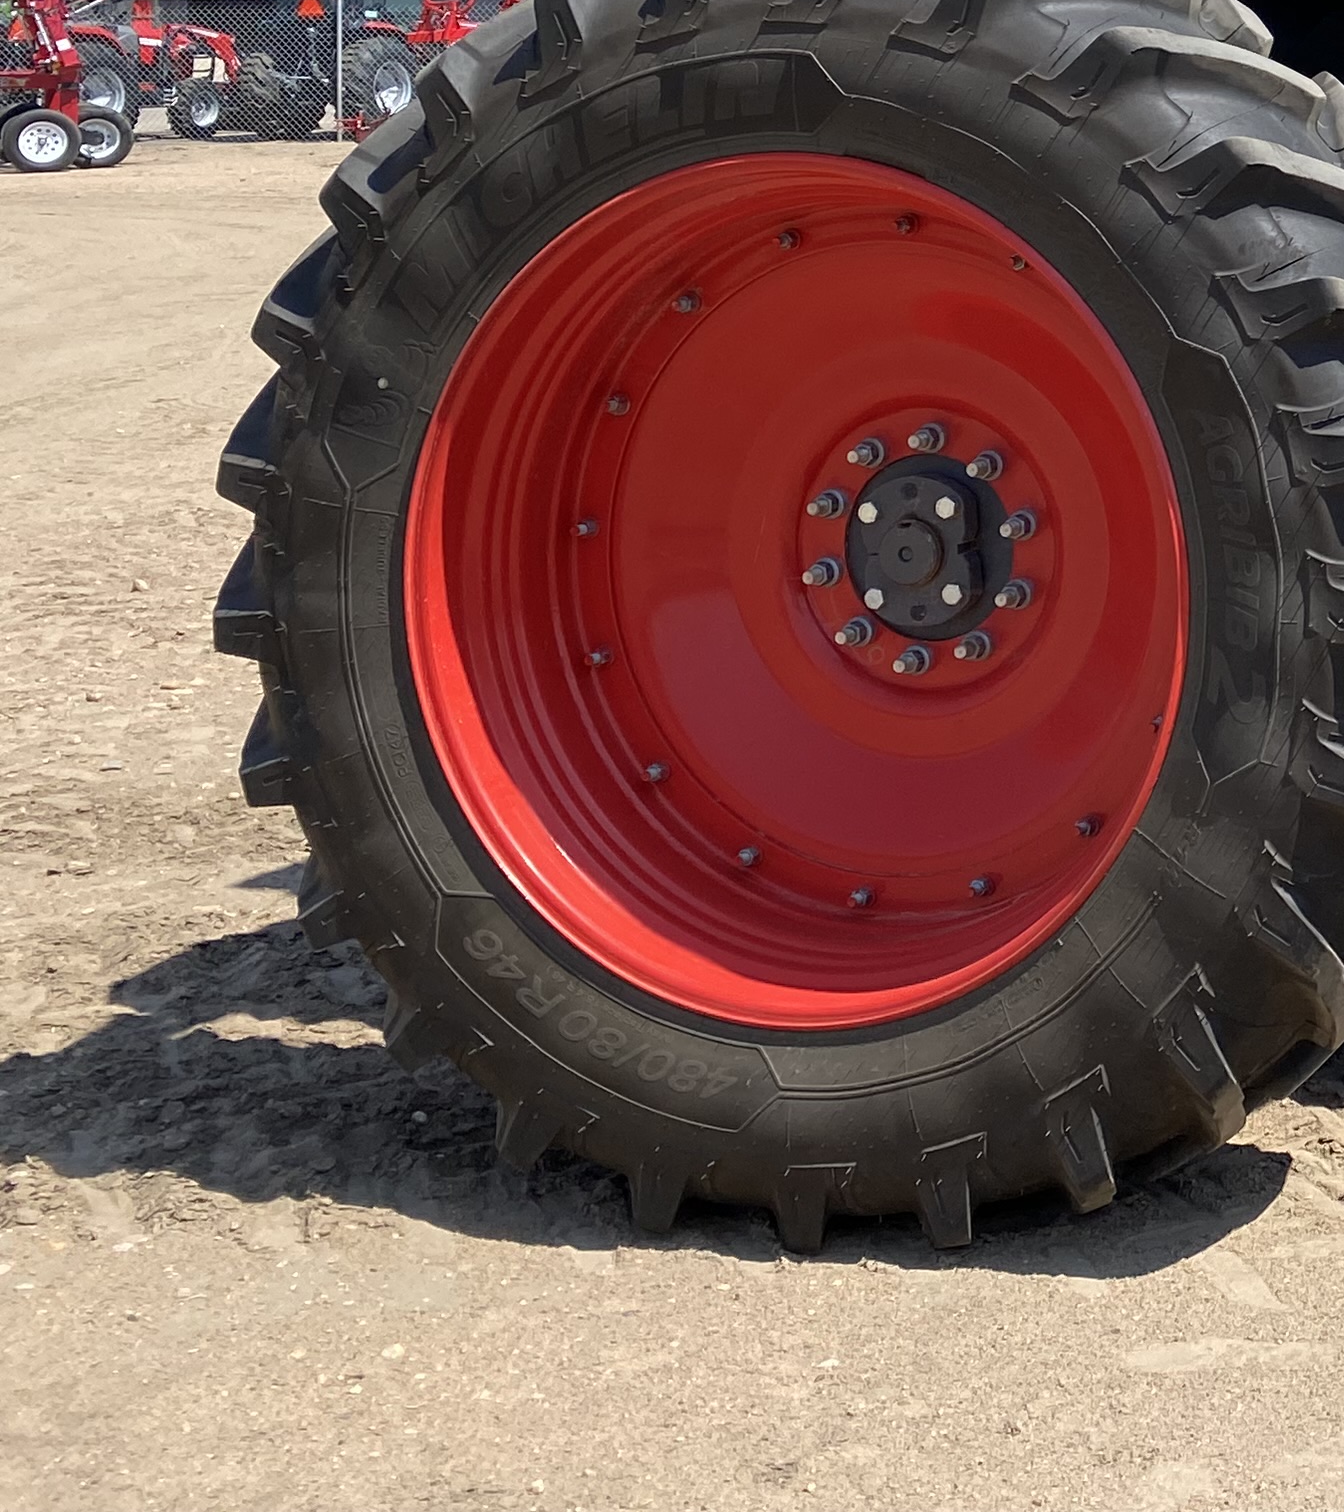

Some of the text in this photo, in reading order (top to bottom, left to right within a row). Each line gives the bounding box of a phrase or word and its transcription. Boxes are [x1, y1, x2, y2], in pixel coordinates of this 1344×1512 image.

[390, 58, 788, 338] MICHELIN
[1196, 406, 1262, 653] AGRIBIB
[557, 1009, 740, 1100] 480/80
